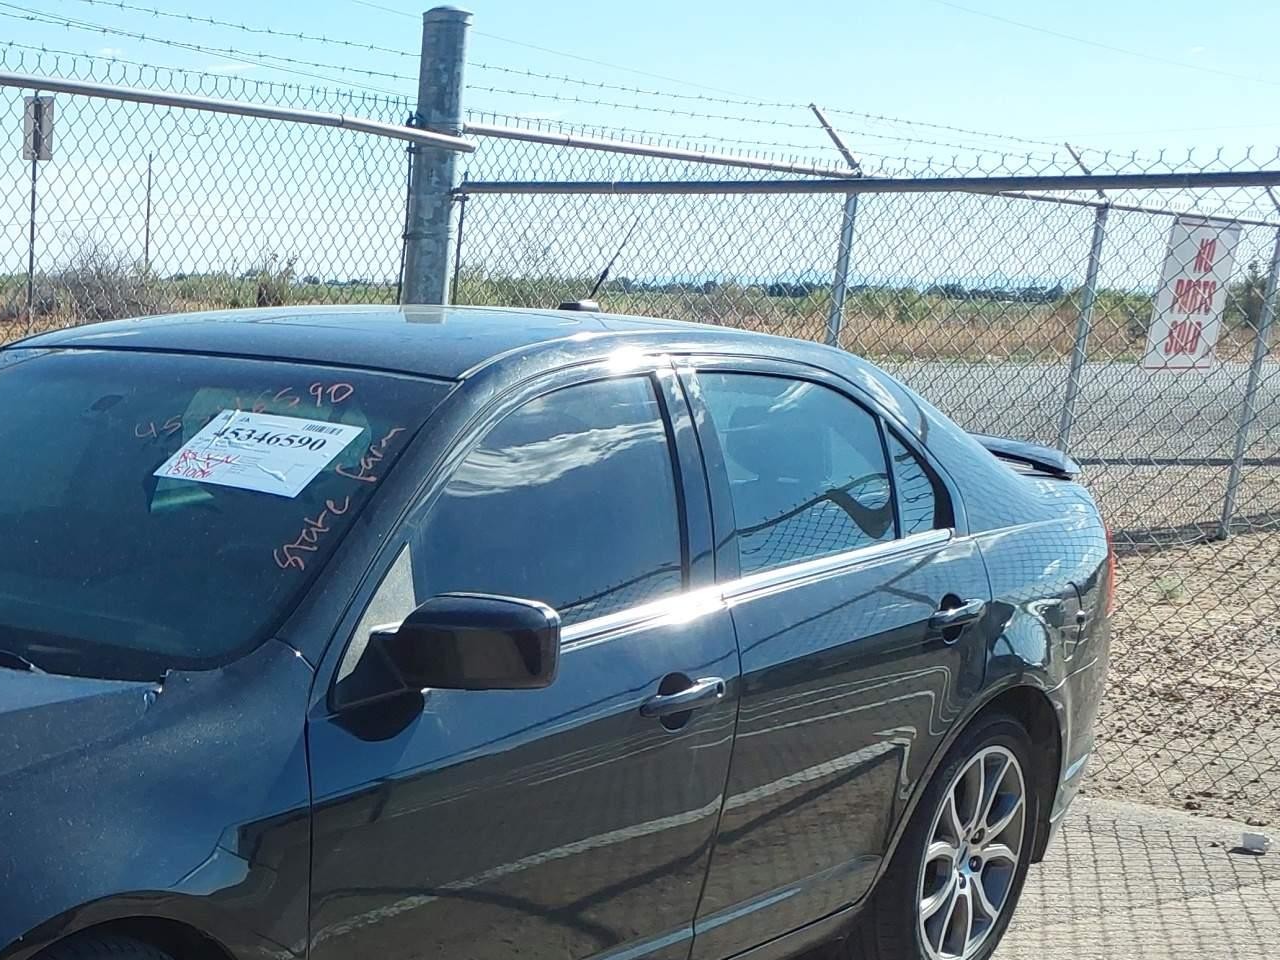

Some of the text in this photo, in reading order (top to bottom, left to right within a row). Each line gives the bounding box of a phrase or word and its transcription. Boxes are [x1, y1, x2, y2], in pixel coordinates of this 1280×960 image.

[1194, 239, 1217, 273] NO
[1171, 279, 1217, 315] PARTS
[1165, 321, 1202, 354] SOLD
[213, 427, 327, 451] 45346590
